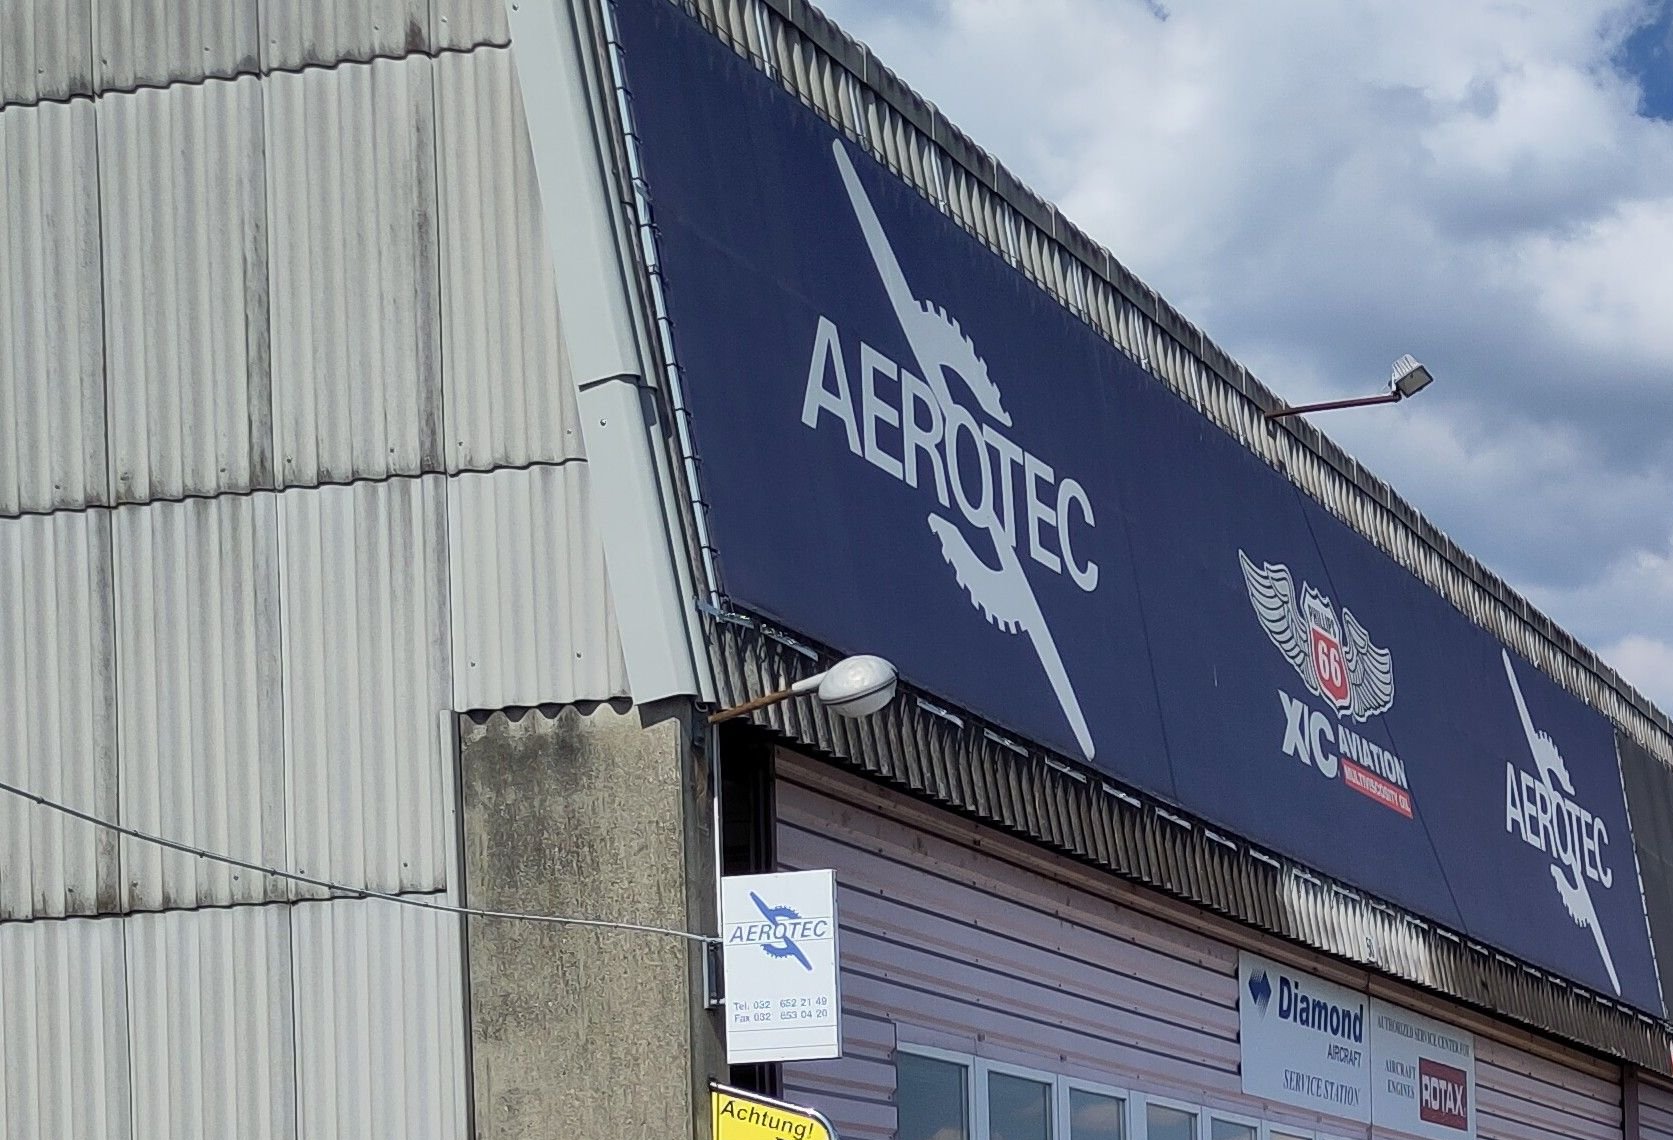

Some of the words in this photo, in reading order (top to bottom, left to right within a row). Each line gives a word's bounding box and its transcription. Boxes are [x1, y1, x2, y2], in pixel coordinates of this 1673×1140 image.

[802, 316, 1099, 592] AEROTEC
[1318, 640, 1342, 688] 66
[1338, 724, 1408, 789] AVIATION
[1506, 762, 1613, 889] AEROTEC
[729, 920, 829, 943] AEROTEC
[733, 1002, 749, 1011] Tel.
[753, 1001, 771, 1009] 032
[801, 998, 811, 1007] 21
[734, 1014, 750, 1022] Fax
[753, 1013, 771, 1021] 032
[801, 1010, 812, 1018] 04
[816, 1009, 828, 1018] 20
[1278, 975, 1364, 1044] Diamond
[1327, 1043, 1362, 1068] AIRCRAFT
[1385, 1059, 1416, 1080] AIRCRAFT
[1283, 1069, 1322, 1098] SERVICE
[1323, 1078, 1360, 1106] STATION
[1387, 1079, 1415, 1099] ENGINES
[1422, 1075, 1465, 1117] ROTAX
[721, 1100, 814, 1140] Achtung!
